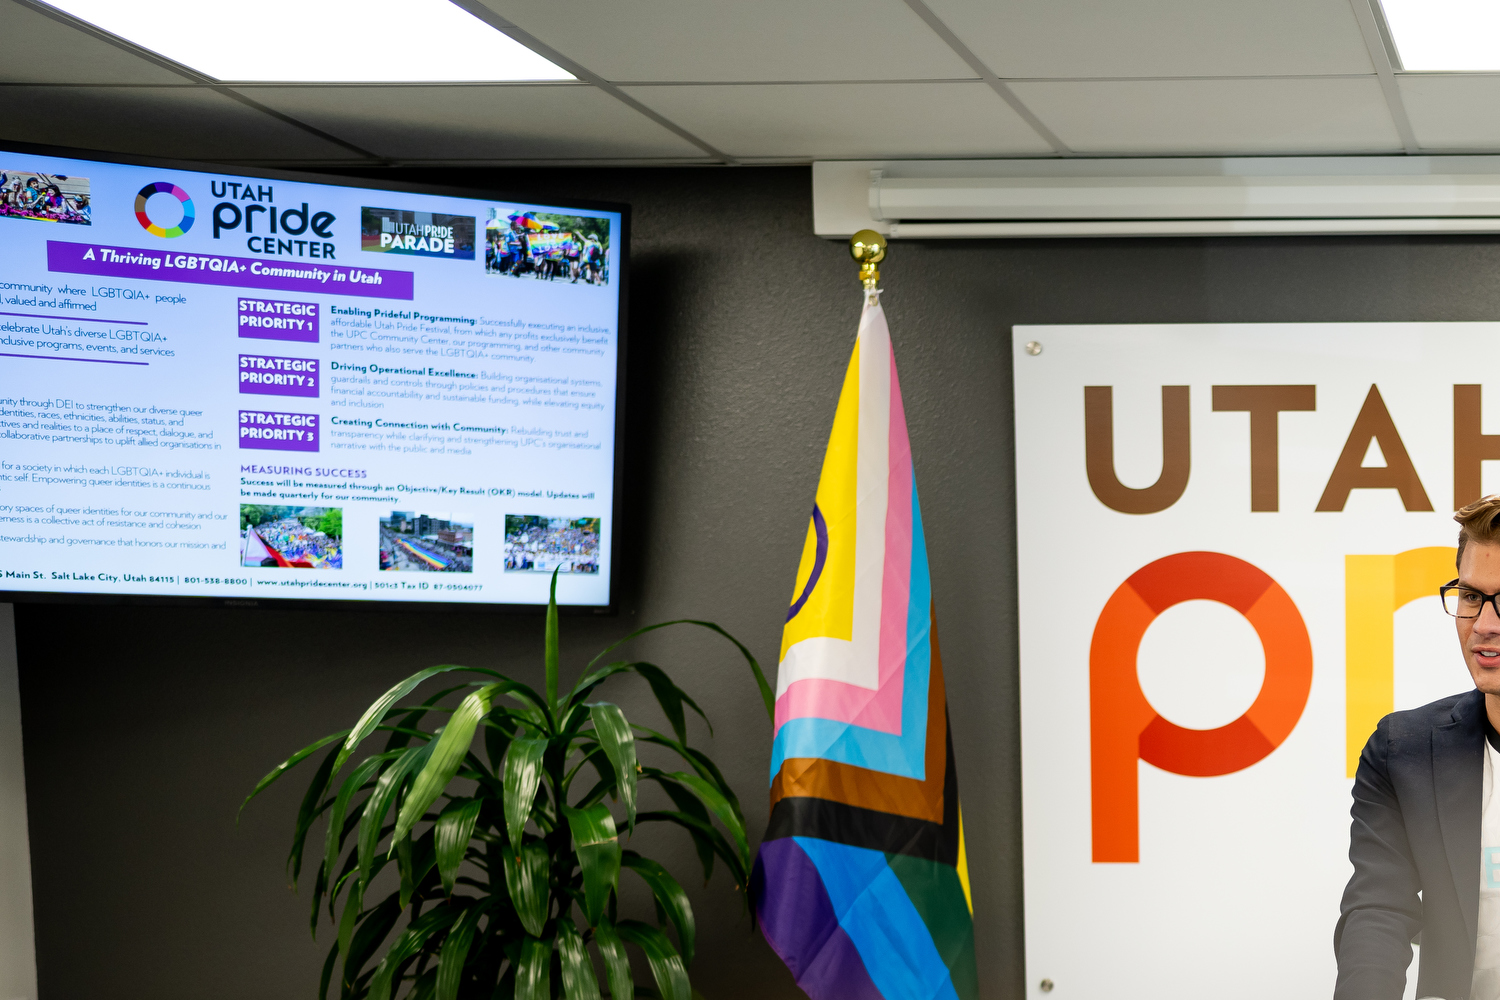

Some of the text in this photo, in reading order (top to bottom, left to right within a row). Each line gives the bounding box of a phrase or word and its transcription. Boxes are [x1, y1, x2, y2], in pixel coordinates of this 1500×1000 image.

[211, 180, 273, 203] UTAH
[213, 202, 336, 239] pride
[247, 236, 336, 260] CENTER
[381, 233, 454, 254] PARADE
[82, 247, 382, 284] A Thriving LGBTQIA+ Community in Utah
[4, 294, 96, 311] valued and affirmed
[57, 284, 86, 295] where
[91, 286, 149, 299] LGBTQIA+
[155, 293, 186, 304] people
[239, 300, 316, 316] STRATEGIC
[330, 305, 479, 326] Enabling Prideful Programming:
[240, 315, 313, 331] PRIORITY 1
[41, 324, 72, 336] Utah's
[73, 326, 107, 338] diverse
[109, 329, 166, 342] LGBTQIA+
[0, 335, 175, 356] nclusive programs, events, and services
[240, 357, 316, 372] STRATEGIC
[331, 361, 479, 377] Driving Operational Excellence:
[241, 372, 315, 387] PRIORITY 2
[19, 397, 54, 409] through
[55, 399, 73, 408] DEI
[86, 403, 131, 415] strengthen
[148, 405, 177, 414] diverse
[179, 409, 202, 417] queer
[240, 412, 315, 427] STRATEGIC
[330, 416, 372, 428] Creating
[374, 418, 428, 428] Connection
[452, 424, 510, 433] Community:
[240, 427, 314, 442] PRIORITY 3
[240, 464, 366, 478] MEASURING SUCCESS
[240, 477, 273, 485] Success
[349, 482, 383, 492] through
[396, 484, 457, 494] Objective/Key
[487, 488, 516, 498] (OKR)
[546, 490, 579, 498] Updates
[51, 571, 69, 579] Salt
[72, 572, 95, 580] Lake
[97, 573, 121, 582] City,
[256, 579, 367, 589] www.utahpridecenter.org
